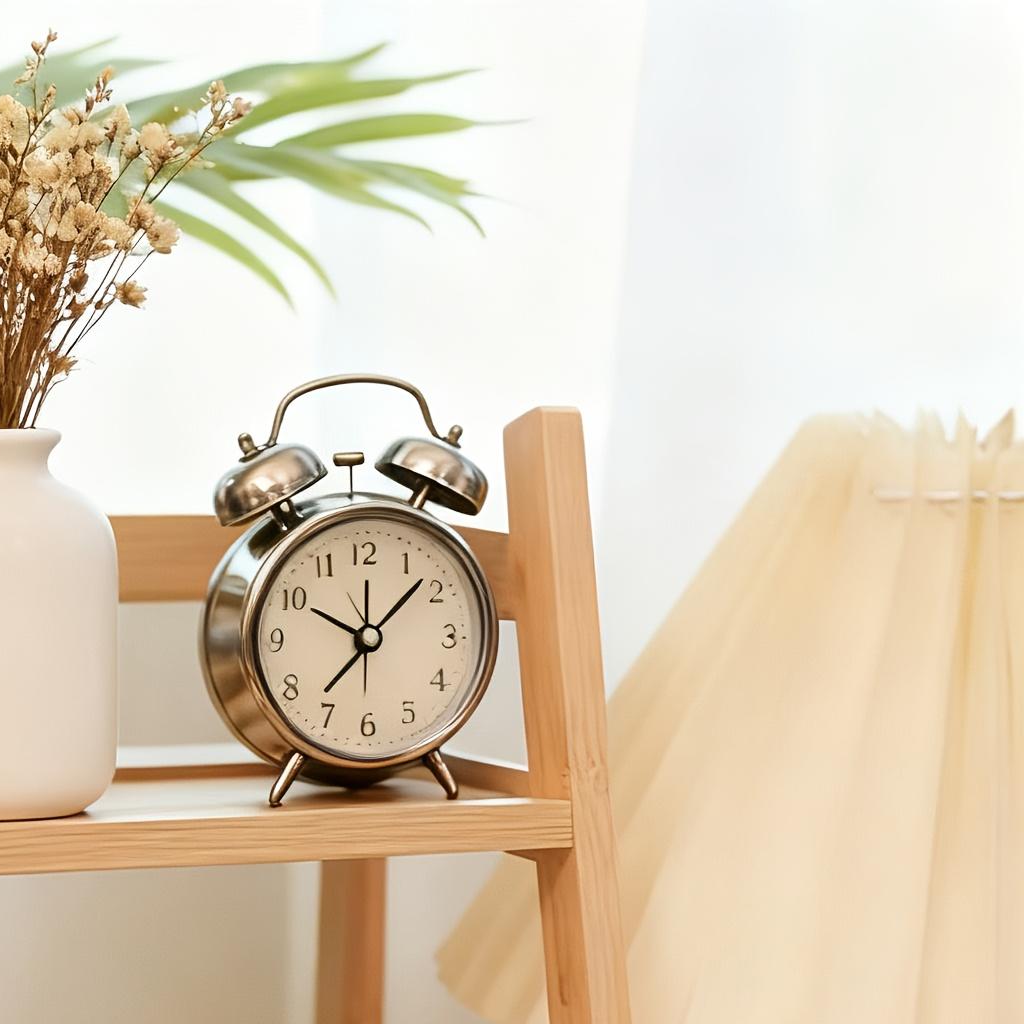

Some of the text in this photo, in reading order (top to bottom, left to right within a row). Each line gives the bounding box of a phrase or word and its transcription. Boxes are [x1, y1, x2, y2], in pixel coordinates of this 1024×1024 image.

[315, 552, 334, 578] 11
[352, 541, 377, 566] 12
[401, 552, 409, 575] 1
[281, 586, 307, 611] 10
[429, 579, 444, 603] 2
[270, 627, 284, 653] 9
[441, 623, 457, 649] 3
[282, 673, 299, 701] 8
[429, 667, 452, 692] 4
[320, 702, 335, 729] 7
[360, 712, 376, 737] 6
[401, 701, 416, 724] 5
